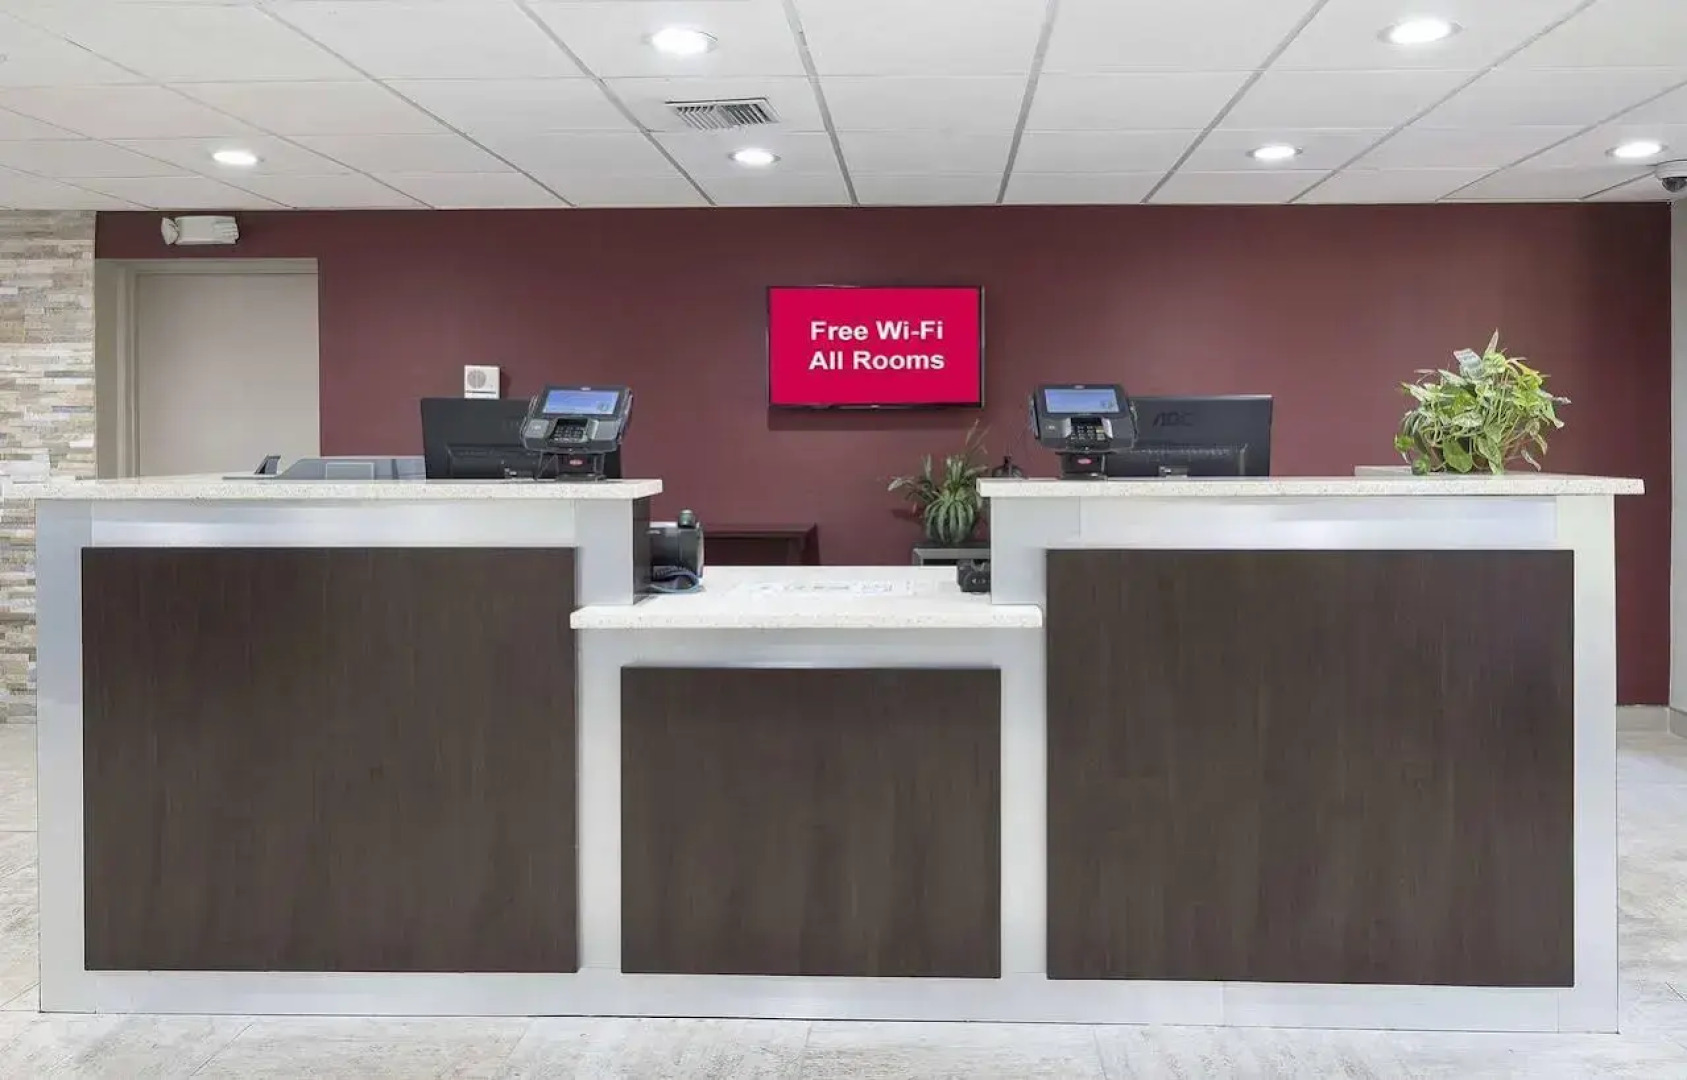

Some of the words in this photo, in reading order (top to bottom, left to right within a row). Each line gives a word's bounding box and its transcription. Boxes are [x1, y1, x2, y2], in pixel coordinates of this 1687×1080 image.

[810, 320, 869, 341] Free
[875, 320, 944, 341] Wi-Fi
[808, 350, 844, 371] All
[852, 350, 945, 371] Rooms
